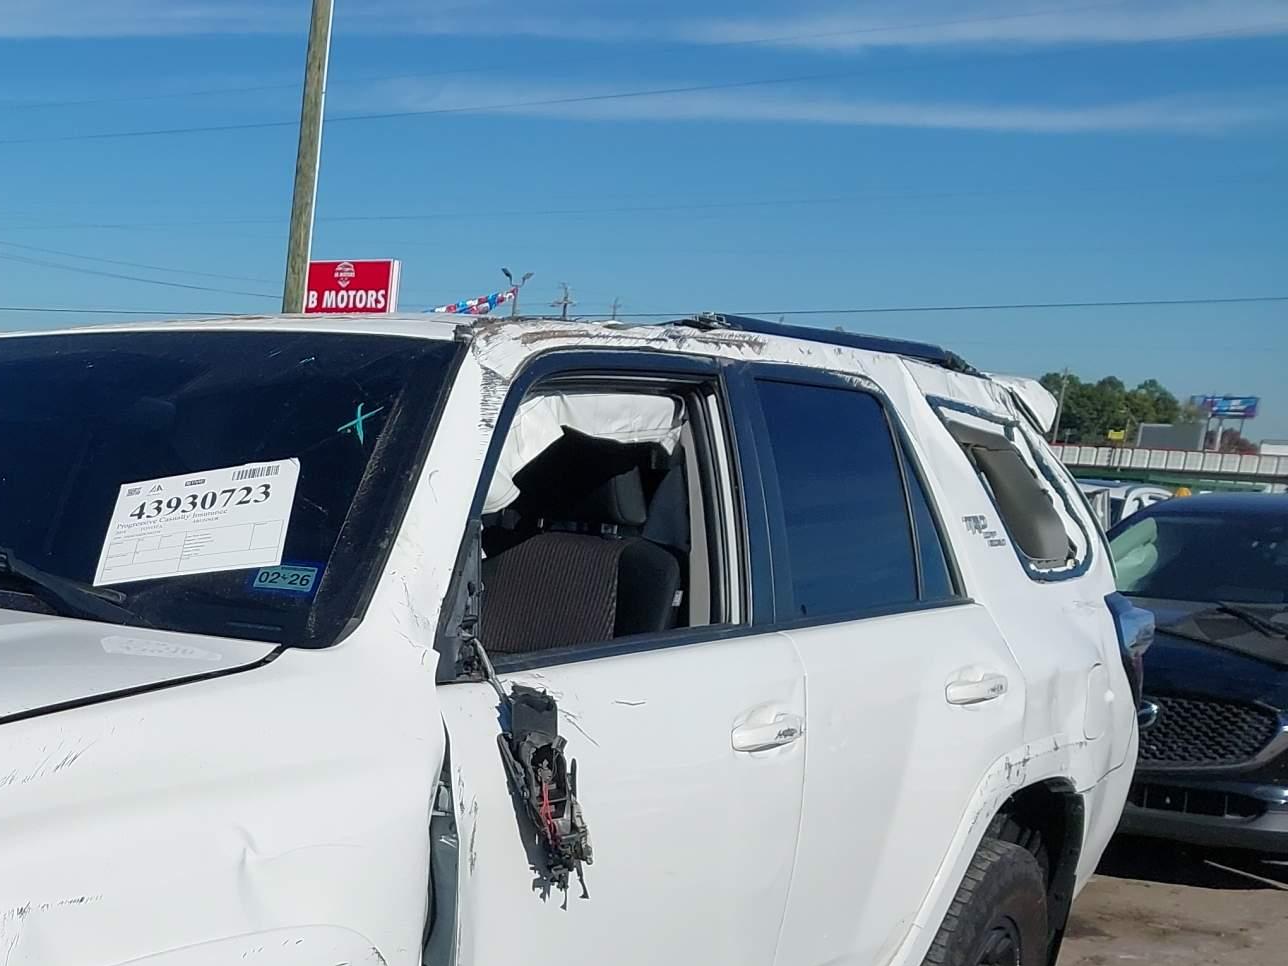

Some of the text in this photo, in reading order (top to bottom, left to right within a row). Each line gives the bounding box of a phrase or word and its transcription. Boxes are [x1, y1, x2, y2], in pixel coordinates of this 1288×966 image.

[322, 289, 386, 309] MOTORS
[129, 483, 272, 520] 43930723
[117, 509, 228, 529] Progressive Casualty Insurance
